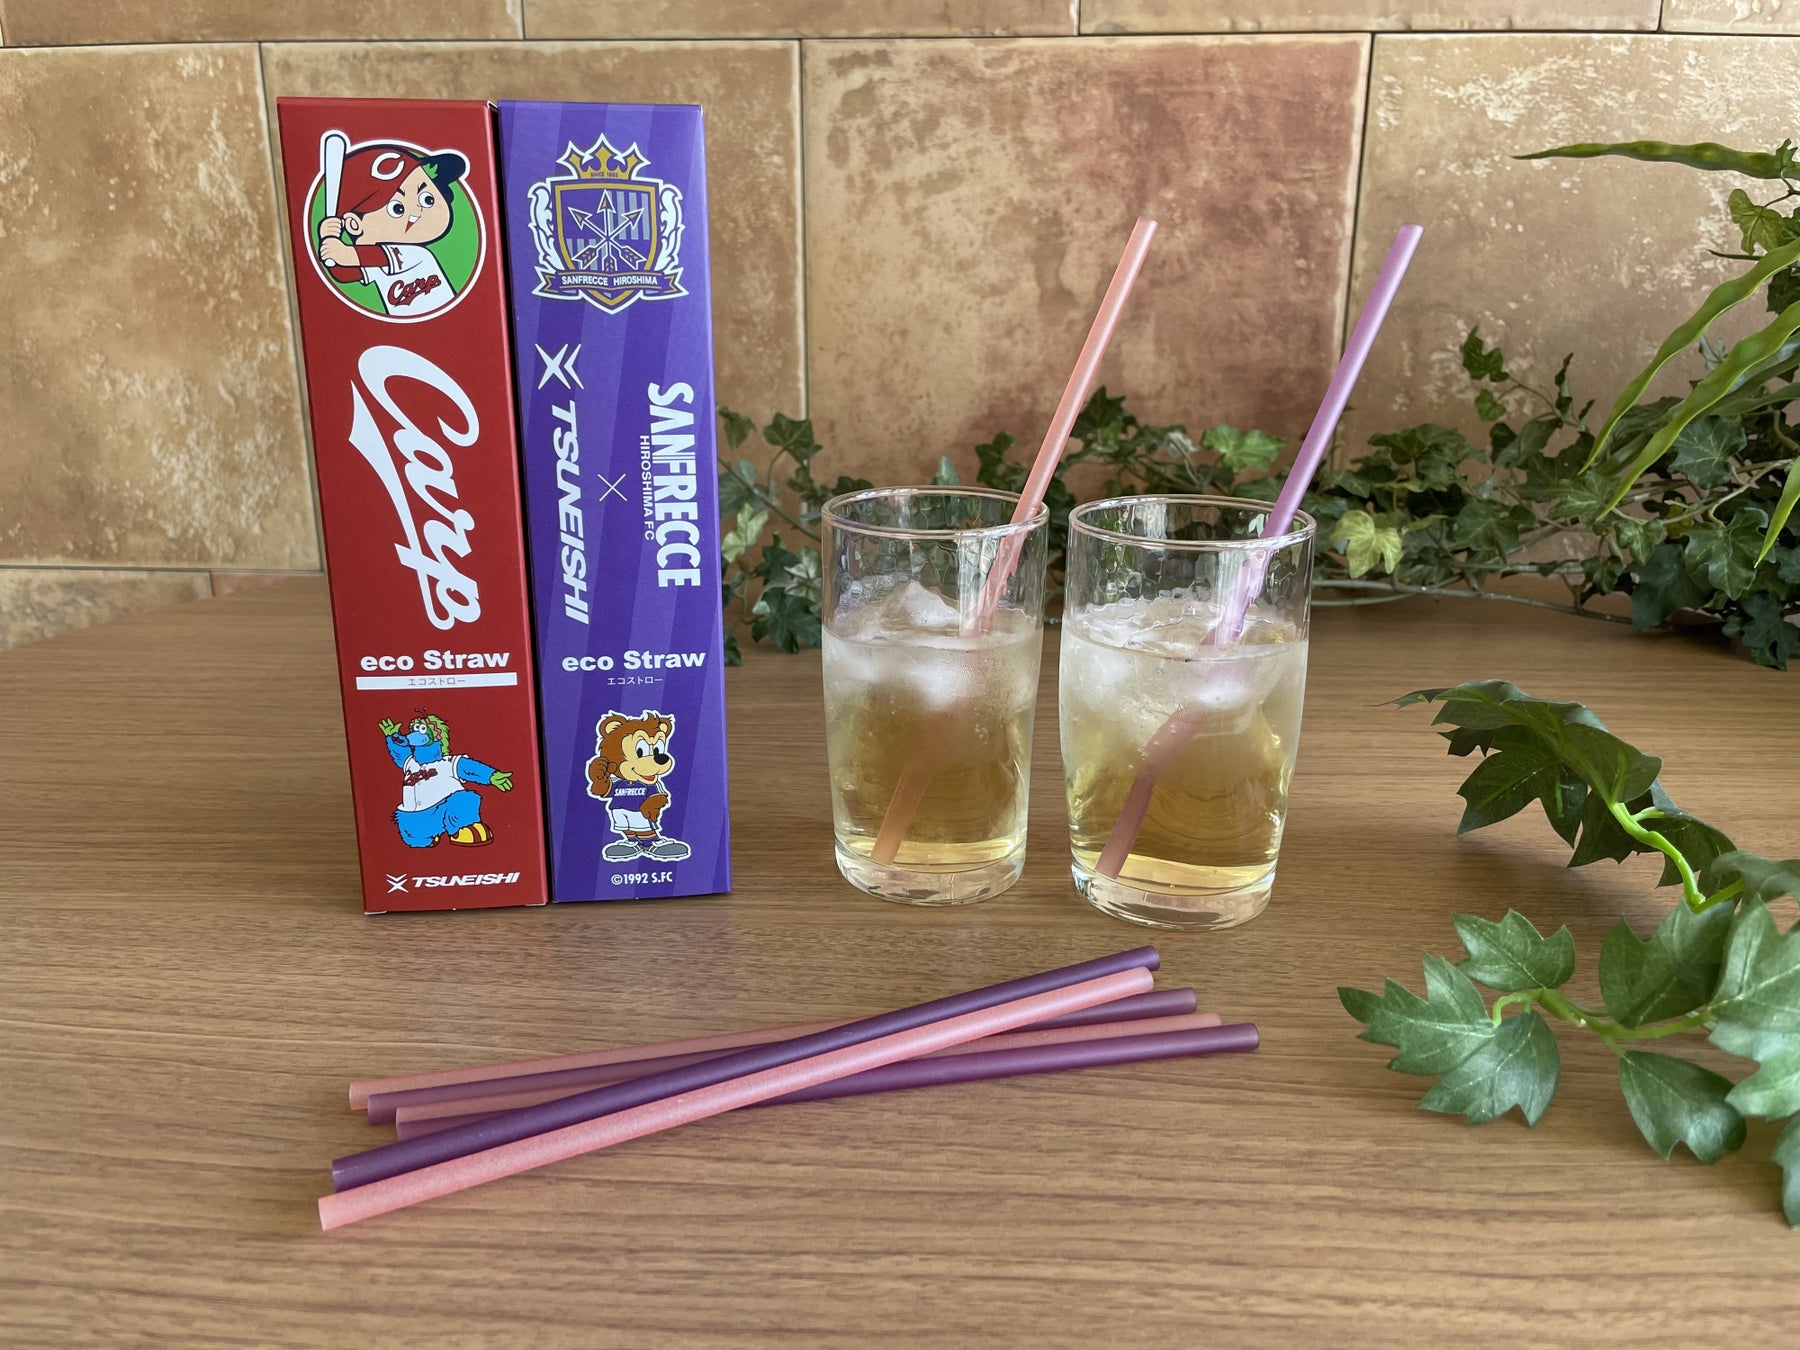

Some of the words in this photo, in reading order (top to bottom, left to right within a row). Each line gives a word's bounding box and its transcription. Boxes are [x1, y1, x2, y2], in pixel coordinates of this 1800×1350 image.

[387, 274, 442, 308] Carp
[561, 275, 608, 286] SANFRECCE
[613, 276, 658, 287] HIROSHIMA
[639, 435, 655, 517] HIROSHIMA
[647, 381, 702, 588] SANFRECCE
[348, 345, 481, 631] Carp
[551, 399, 590, 625] TSUNEISHI
[644, 521, 655, 541] FC
[360, 655, 414, 673] eco
[423, 649, 510, 671] Straw
[562, 656, 615, 673] eco
[623, 650, 706, 671] Straw
[407, 677, 467, 687] エコストロー
[606, 676, 664, 686] エコストロー
[614, 787, 647, 797] SANFRECCE
[411, 872, 521, 889] TSUNEISHI
[610, 873, 648, 886] ©1992
[651, 872, 673, 885] S.FC
